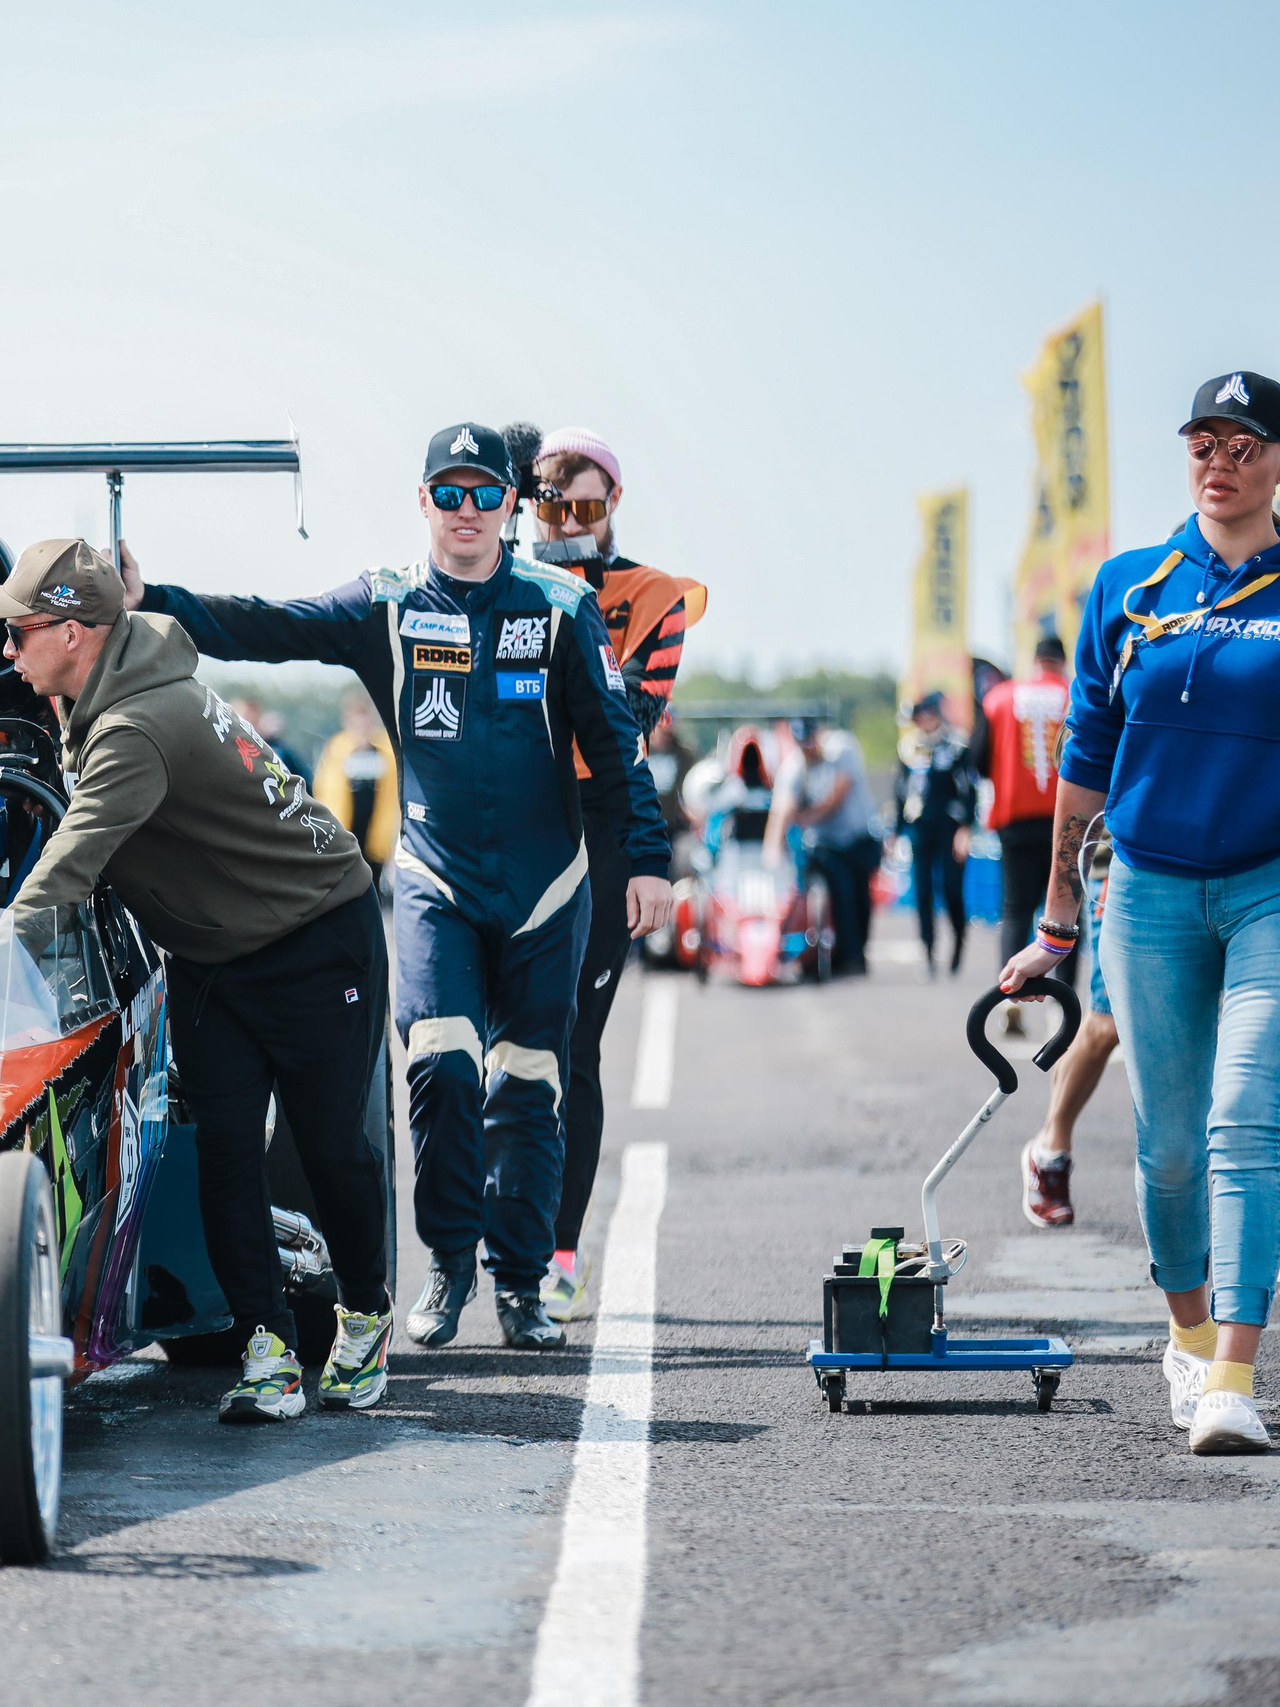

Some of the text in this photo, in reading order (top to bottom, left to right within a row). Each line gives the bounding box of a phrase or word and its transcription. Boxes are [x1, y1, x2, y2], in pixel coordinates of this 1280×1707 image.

[50, 599, 68, 608] TEAM
[502, 617, 549, 636] MAX
[1161, 614, 1193, 632] RDRC
[416, 648, 471, 665] RDRC
[495, 649, 543, 660] MOTORSPORT
[515, 680, 541, 693] ВТБ
